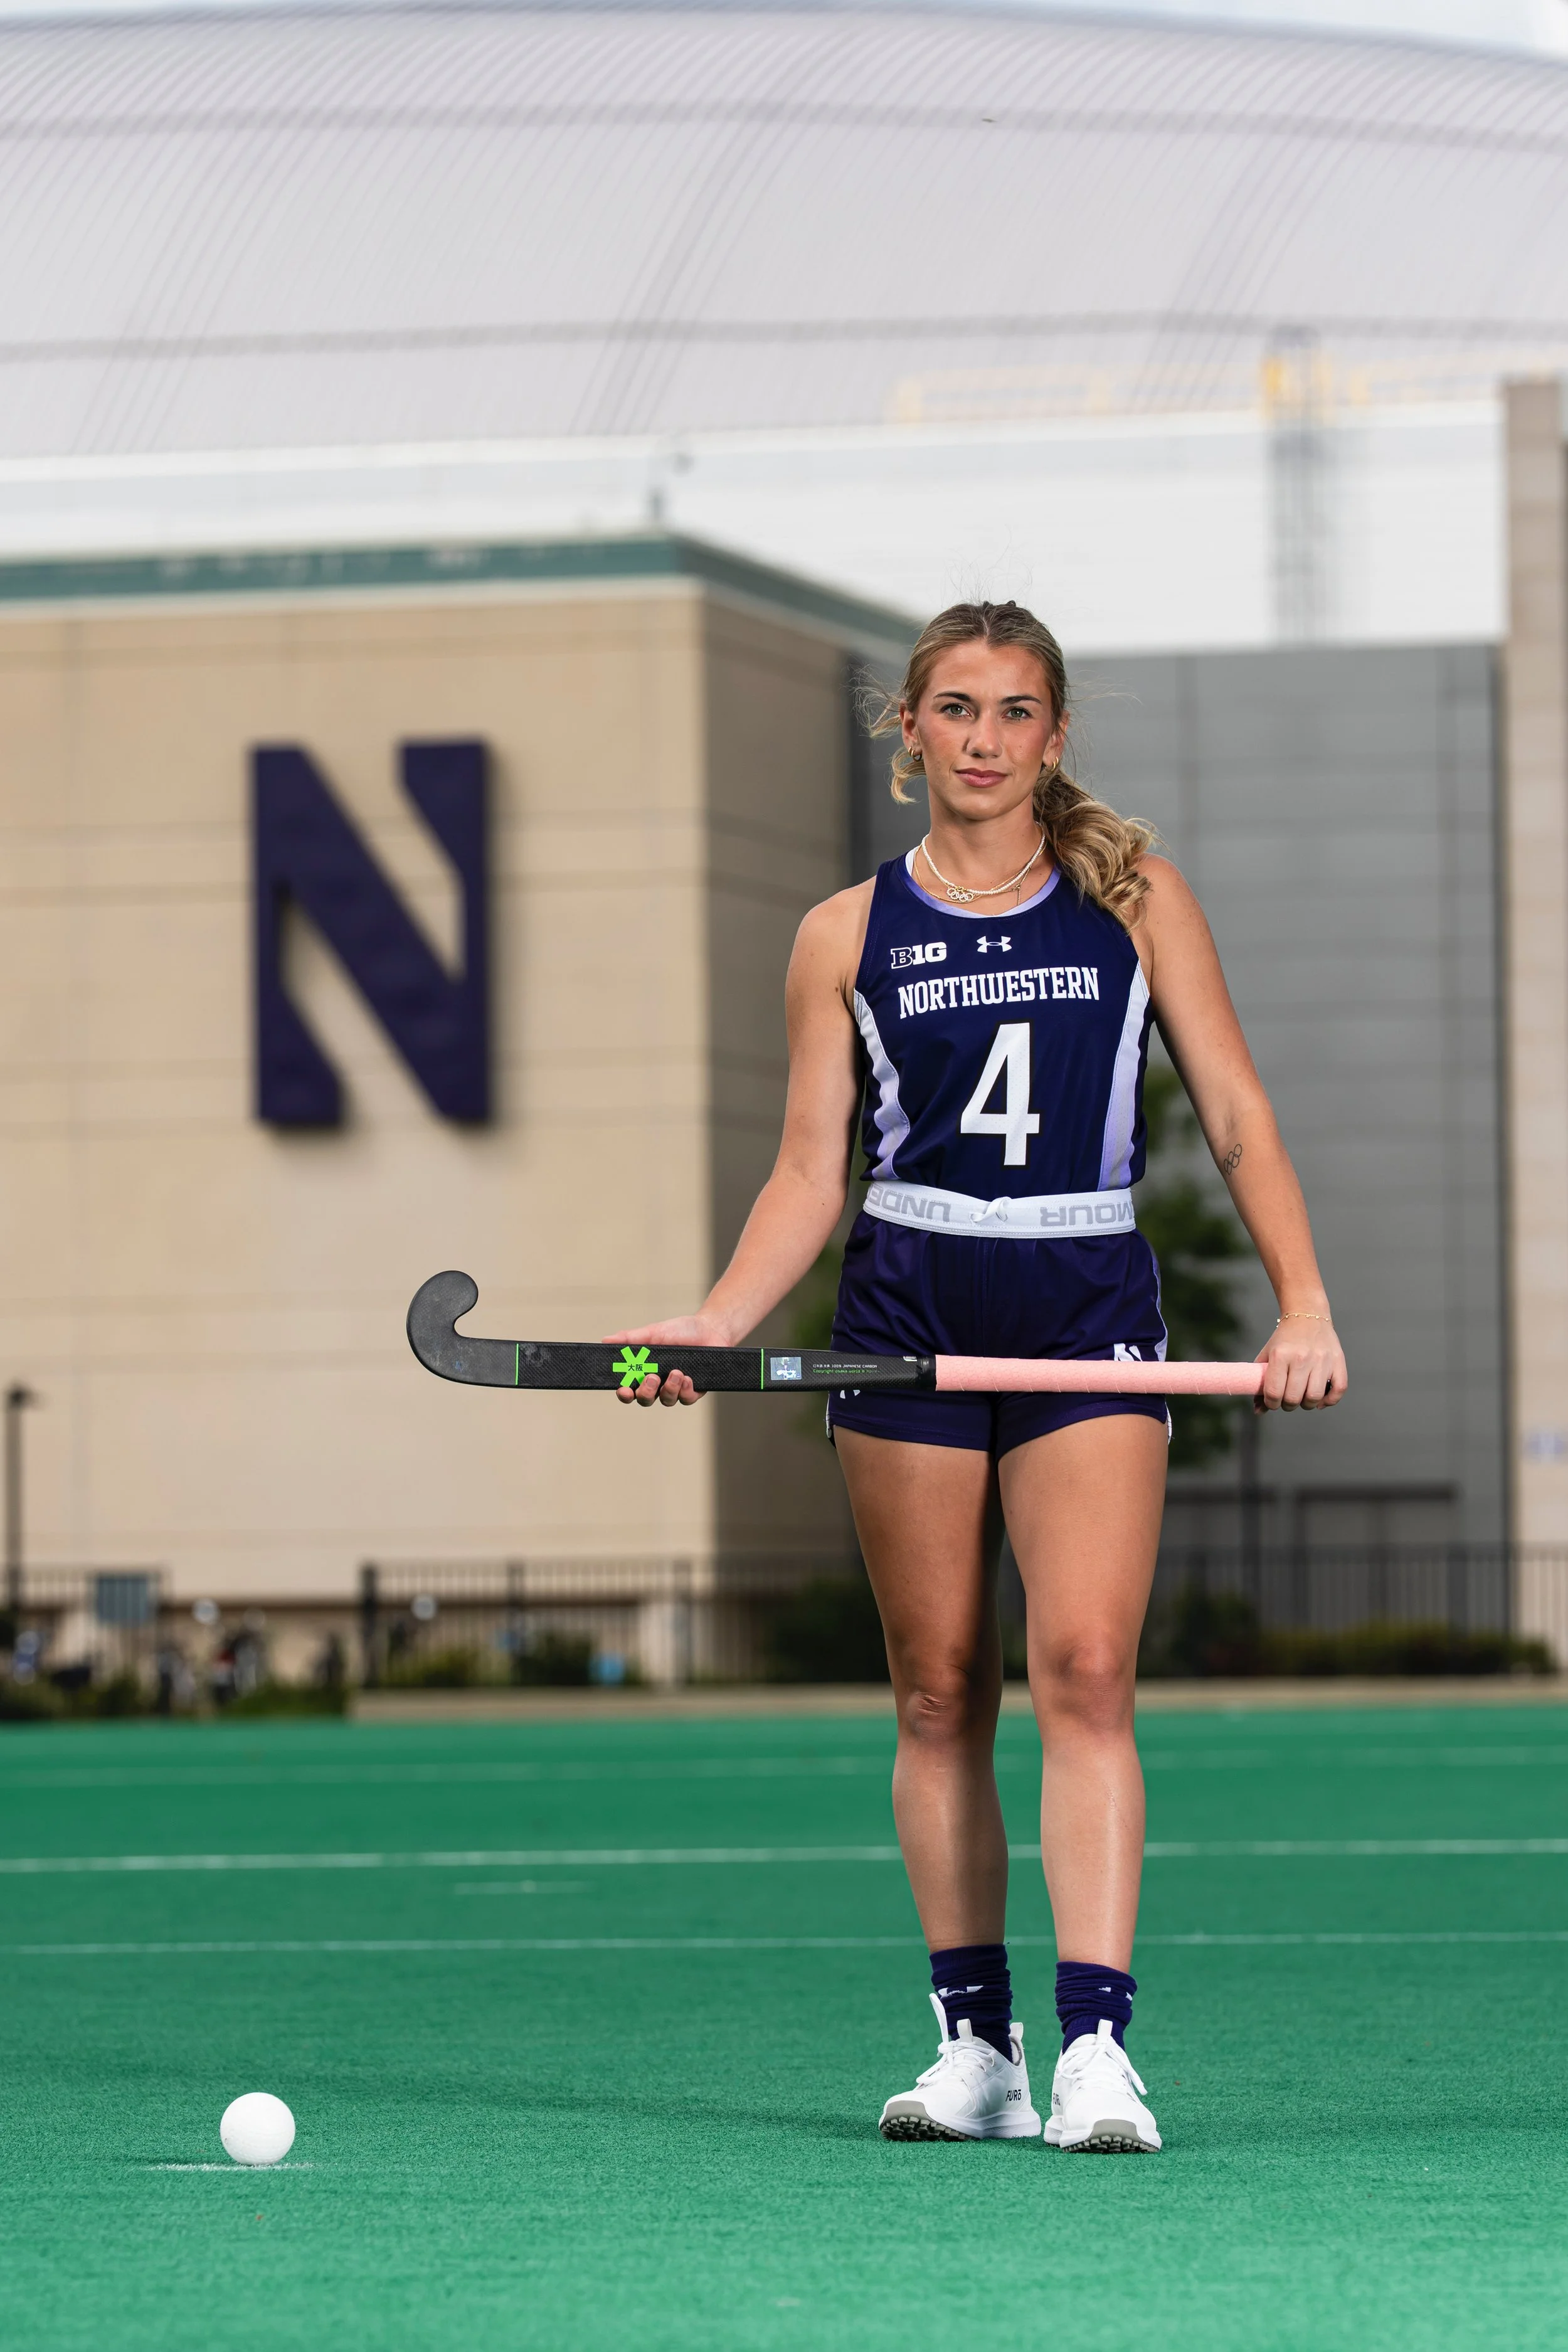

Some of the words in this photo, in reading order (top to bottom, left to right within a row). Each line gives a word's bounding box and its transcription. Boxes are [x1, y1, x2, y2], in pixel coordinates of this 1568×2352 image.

[251, 740, 492, 1130] N
[898, 967, 1100, 1020] NORTHWESTERN
[960, 1022, 1040, 1165] 4
[627, 1364, 644, 1372] 大阪
